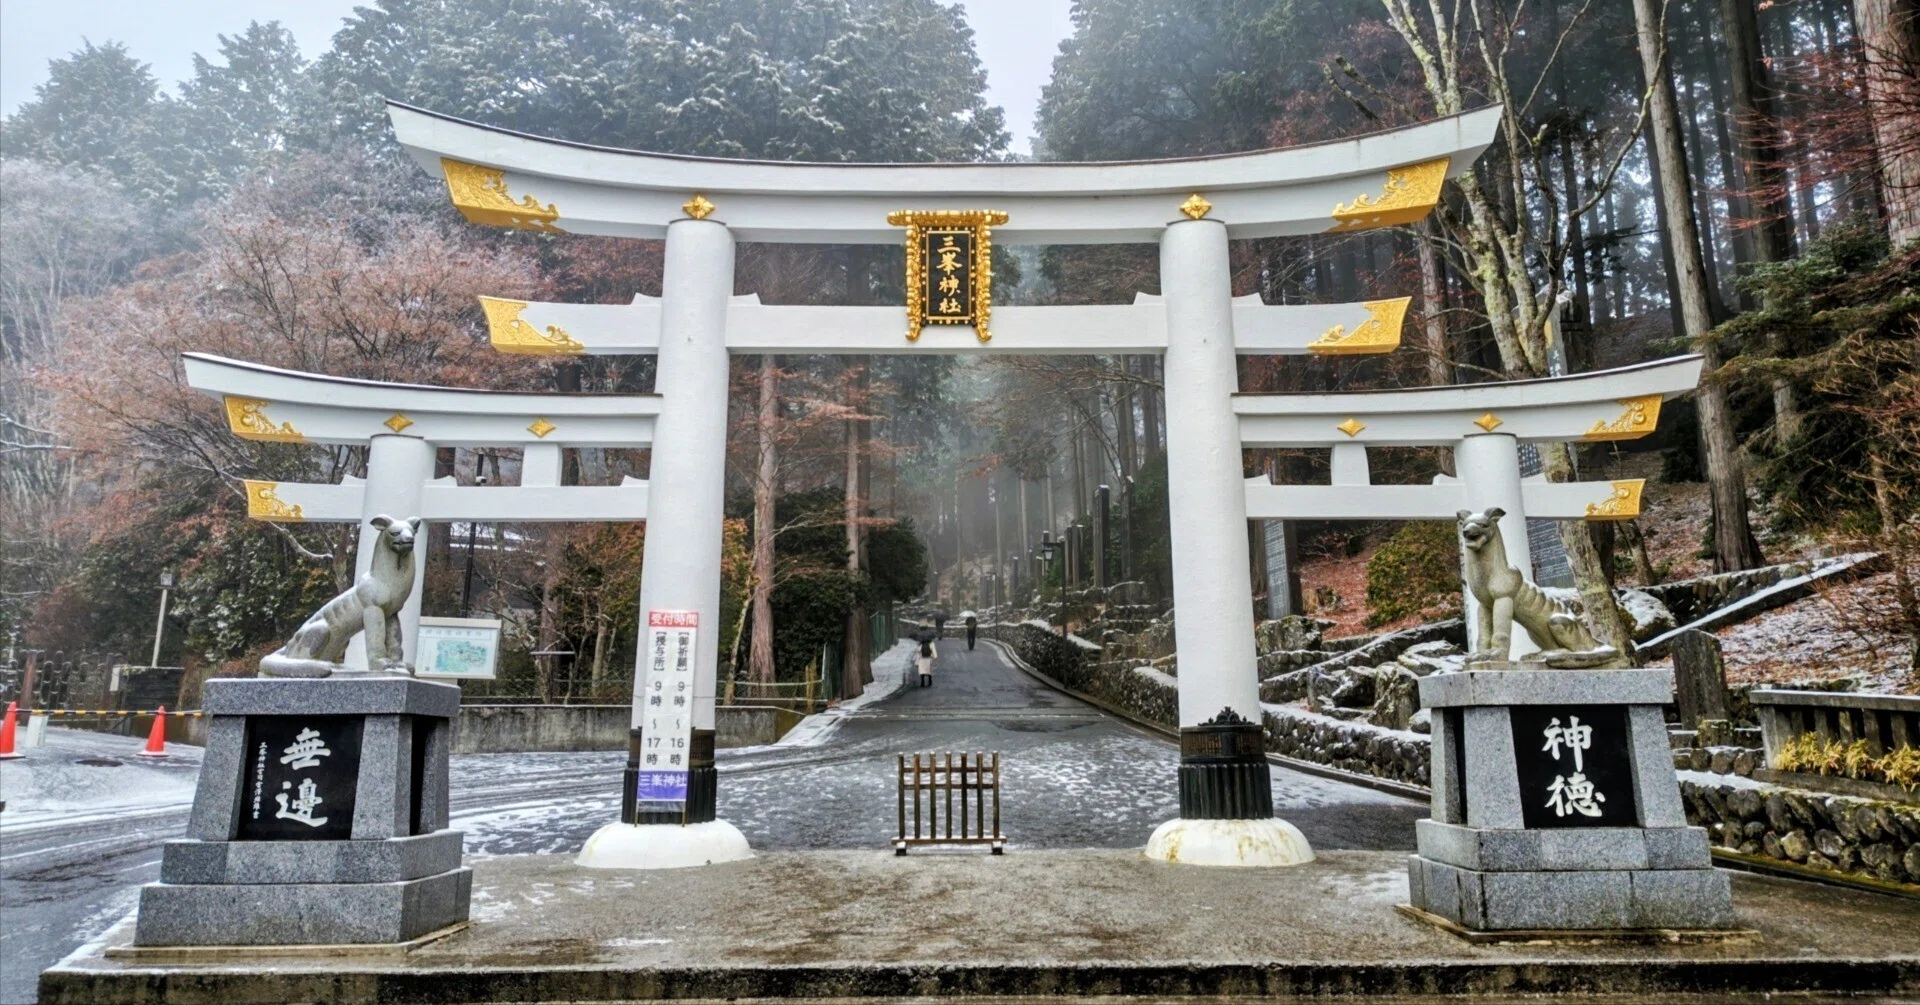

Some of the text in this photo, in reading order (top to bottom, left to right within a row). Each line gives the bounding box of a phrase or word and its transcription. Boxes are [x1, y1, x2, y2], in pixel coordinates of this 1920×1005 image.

[936, 236, 962, 314] 三峯神社
[650, 613, 697, 627] 受付時間
[639, 774, 688, 787] 三峯神社
